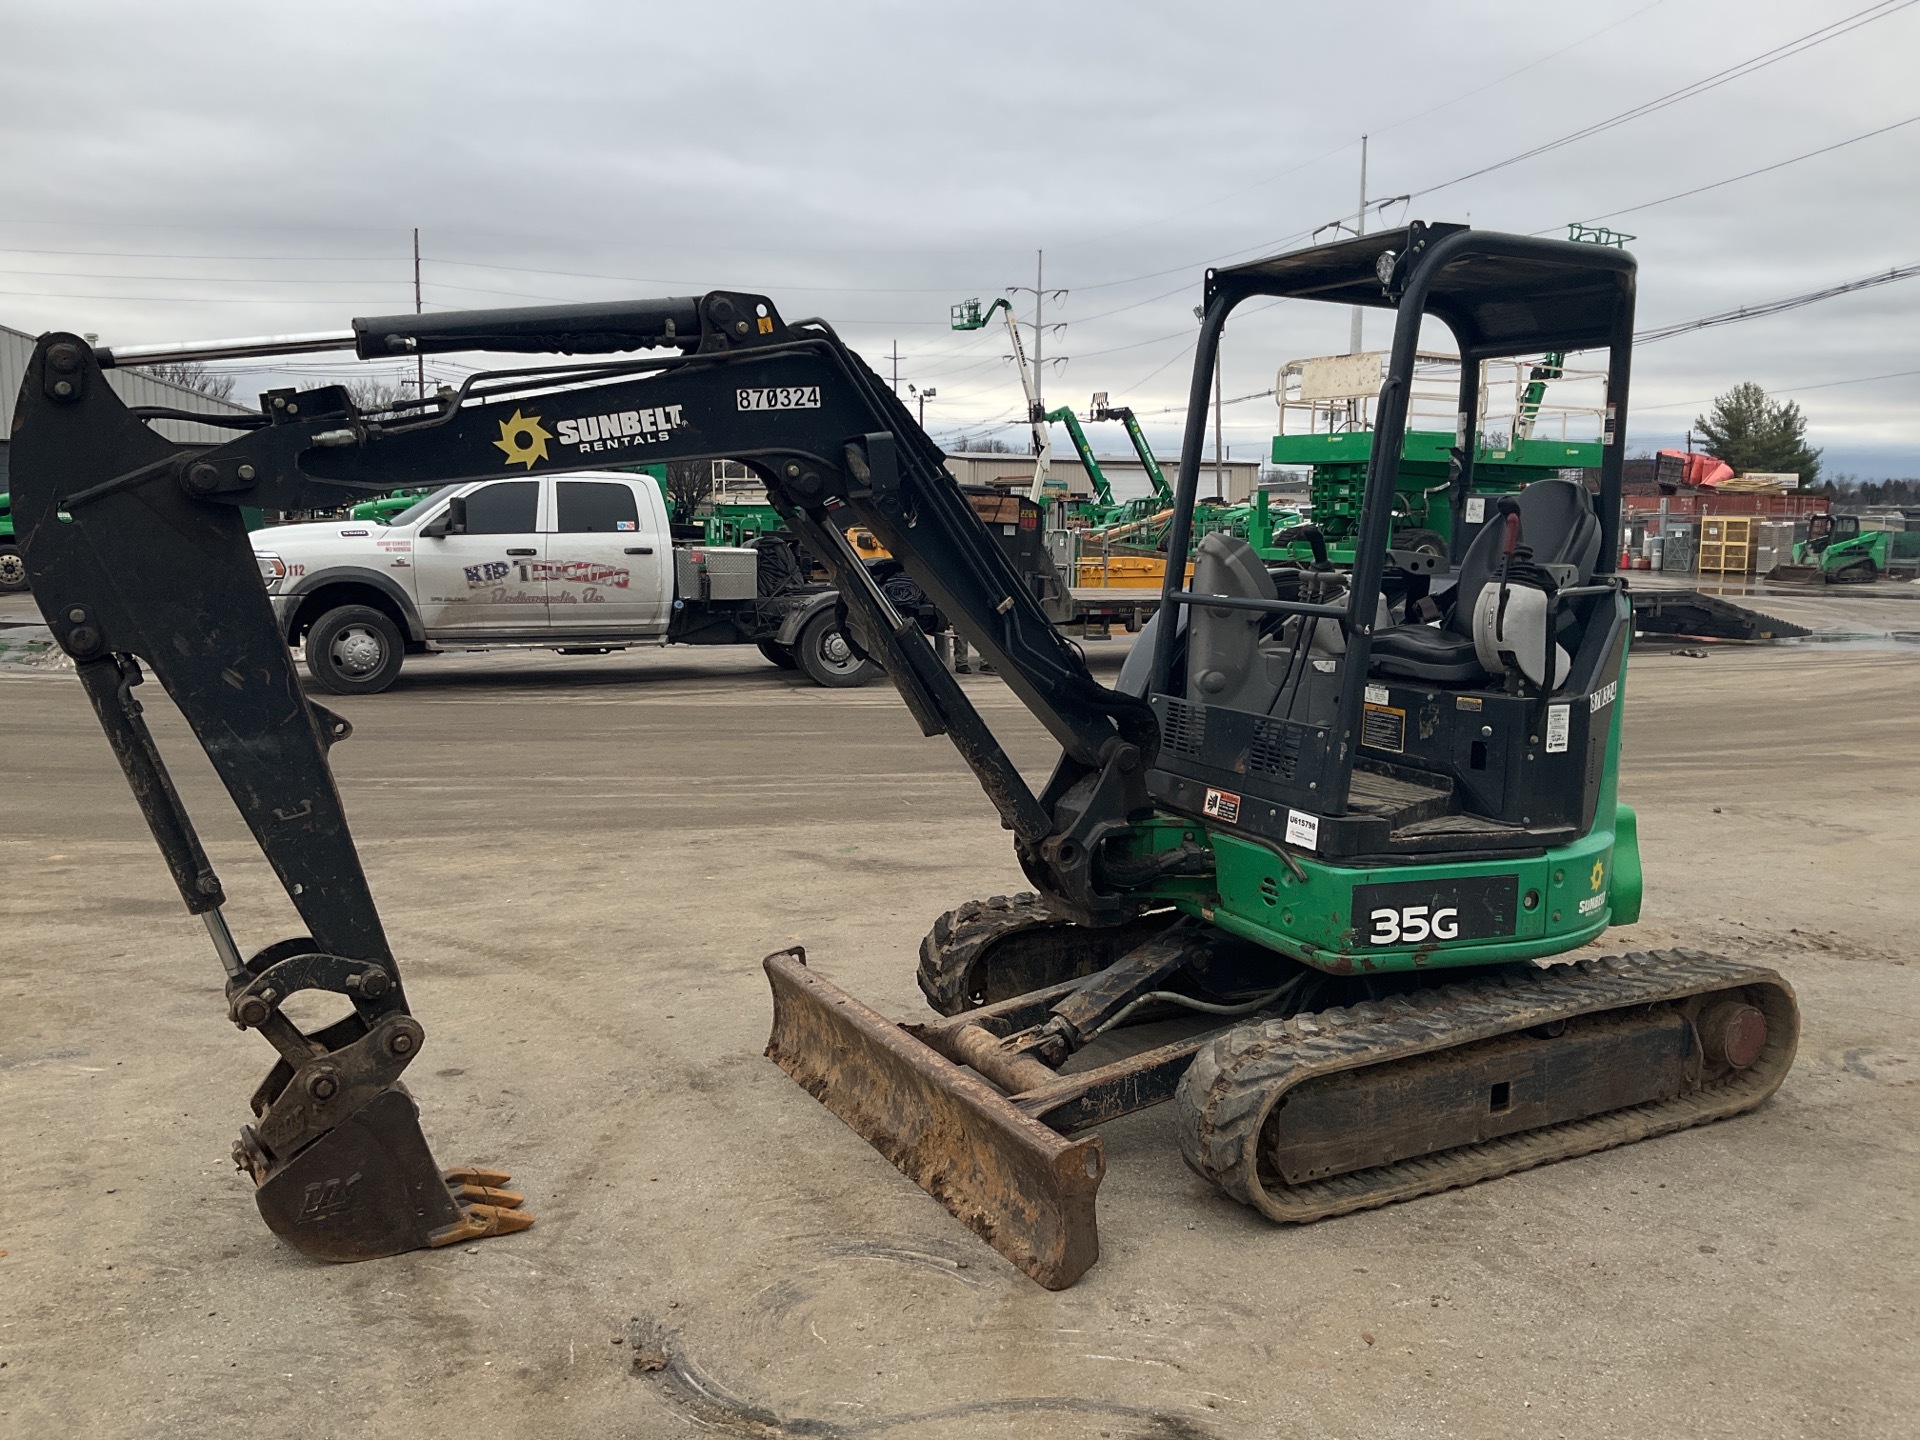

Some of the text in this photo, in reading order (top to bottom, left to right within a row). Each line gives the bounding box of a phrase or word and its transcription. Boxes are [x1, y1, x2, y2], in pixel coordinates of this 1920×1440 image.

[738, 387, 820, 409] 870324
[556, 404, 682, 445] SUNBELT
[579, 431, 670, 453] RENTALS
[288, 565, 305, 576] 112
[463, 558, 630, 590] KIP TRUCKING
[1370, 906, 1458, 945] 35G
